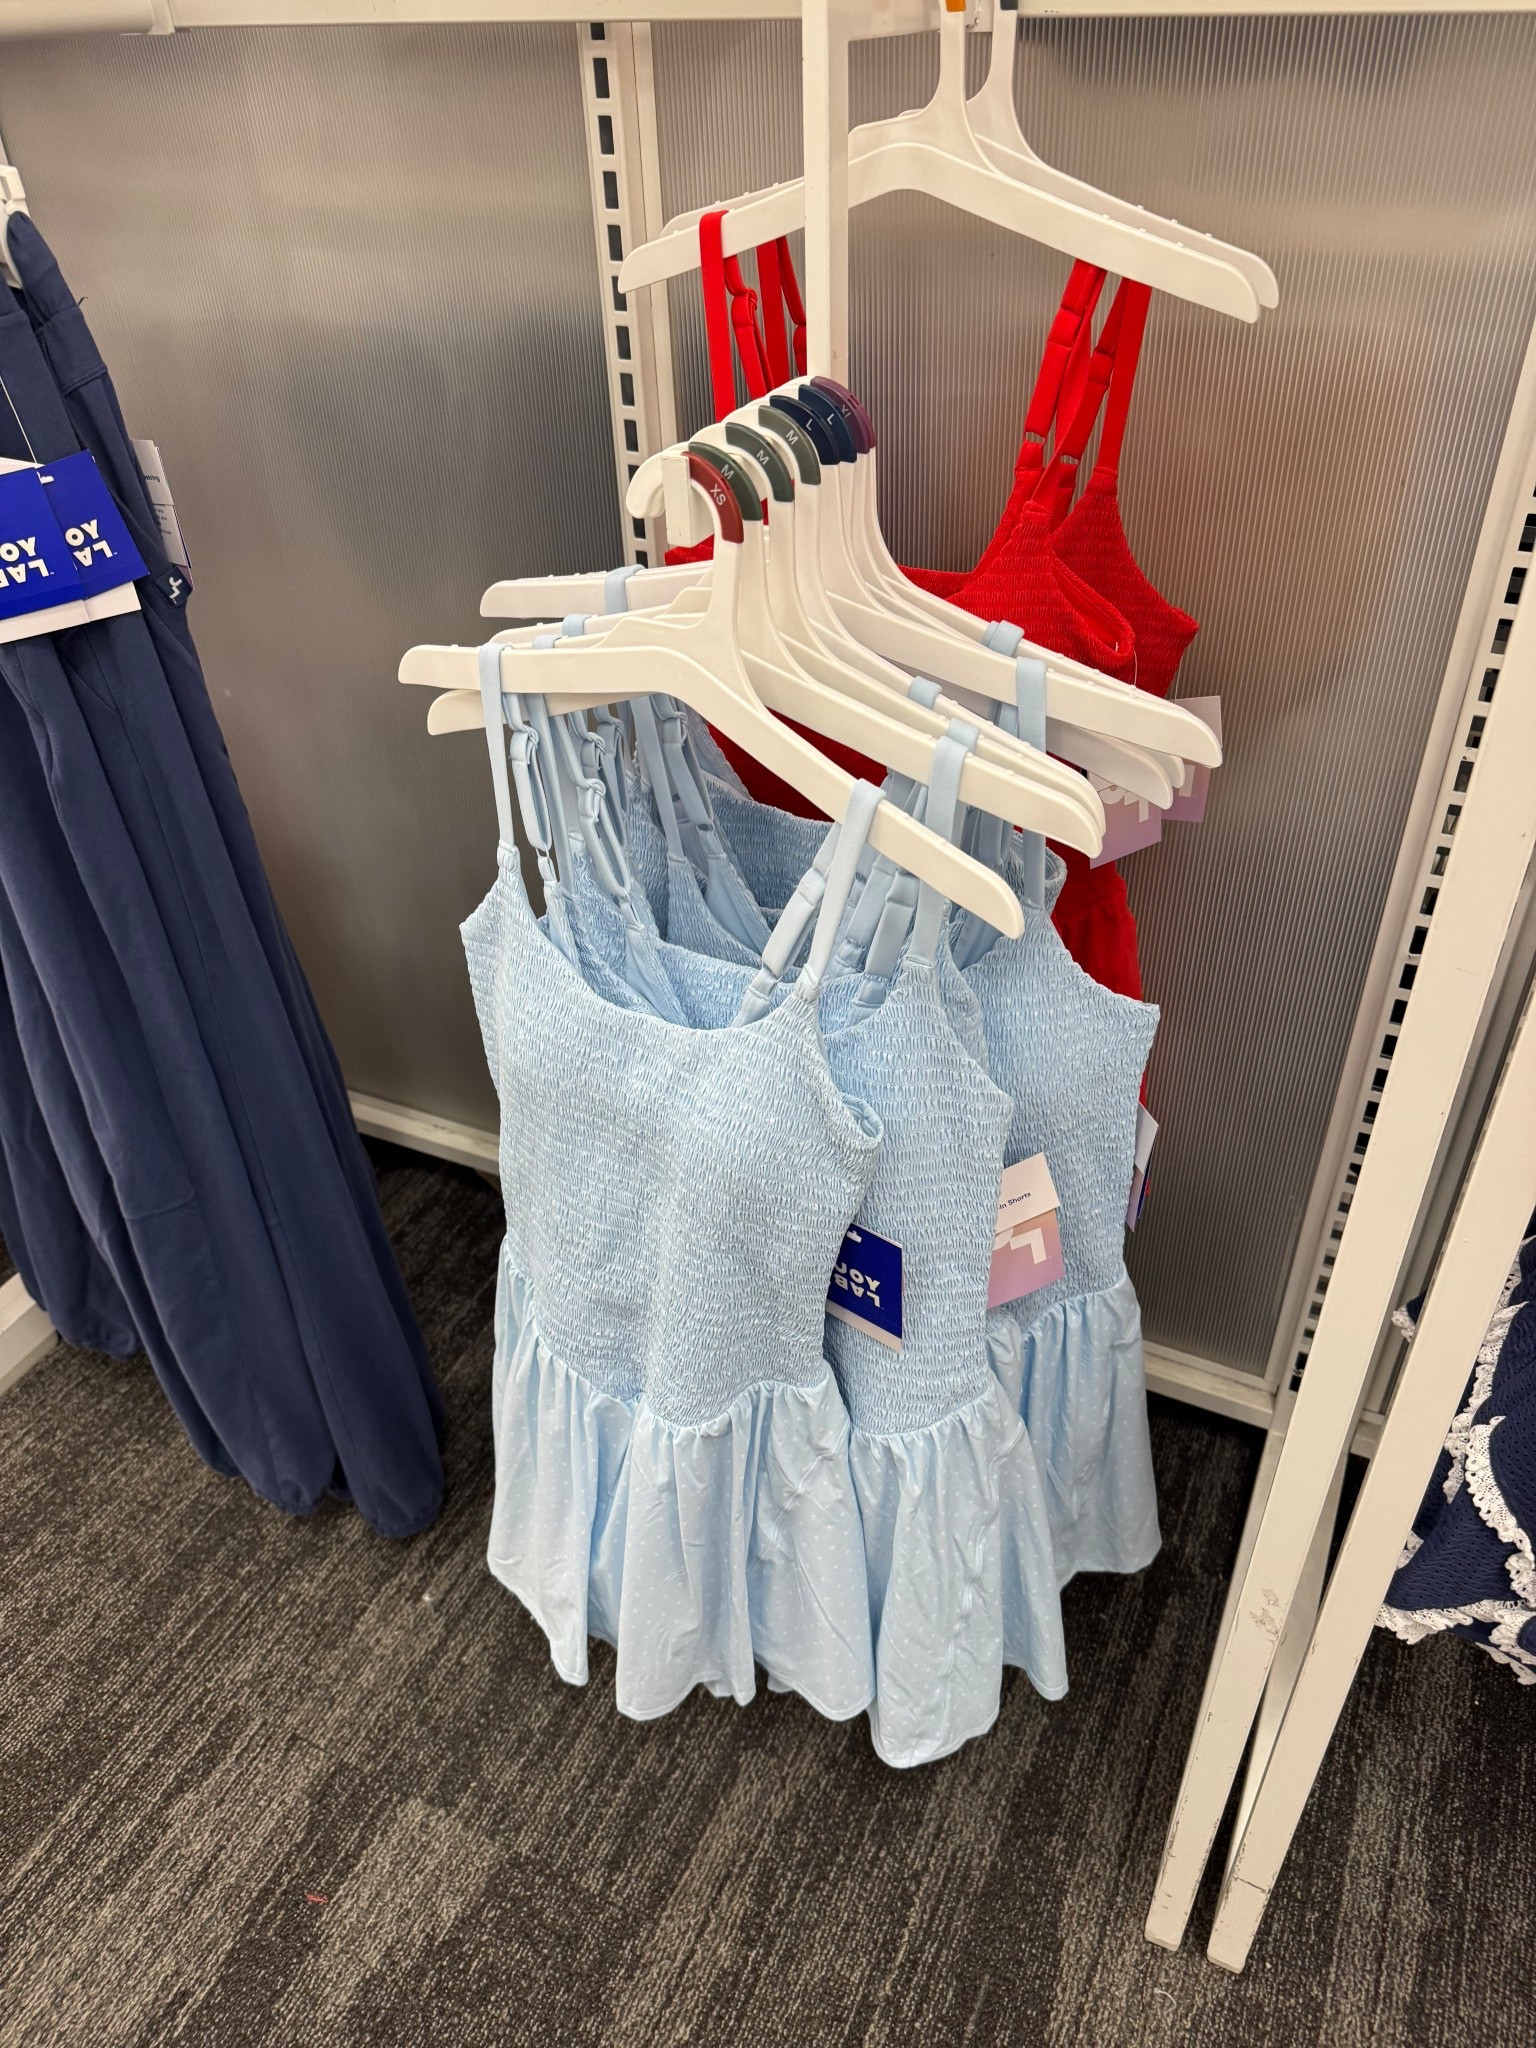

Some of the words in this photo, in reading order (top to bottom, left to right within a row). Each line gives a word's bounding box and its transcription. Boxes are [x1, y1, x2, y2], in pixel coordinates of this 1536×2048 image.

[805, 418, 813, 431] L
[826, 413, 834, 425] L
[785, 429, 799, 445] M
[756, 449, 770, 466] M
[720, 463, 735, 480] M
[709, 483, 726, 506] XS
[65, 518, 100, 547] OY
[0, 536, 37, 563] OY
[73, 540, 114, 567] LA
[1008, 1191, 1032, 1206] Shorts
[833, 1273, 881, 1308] LAB
